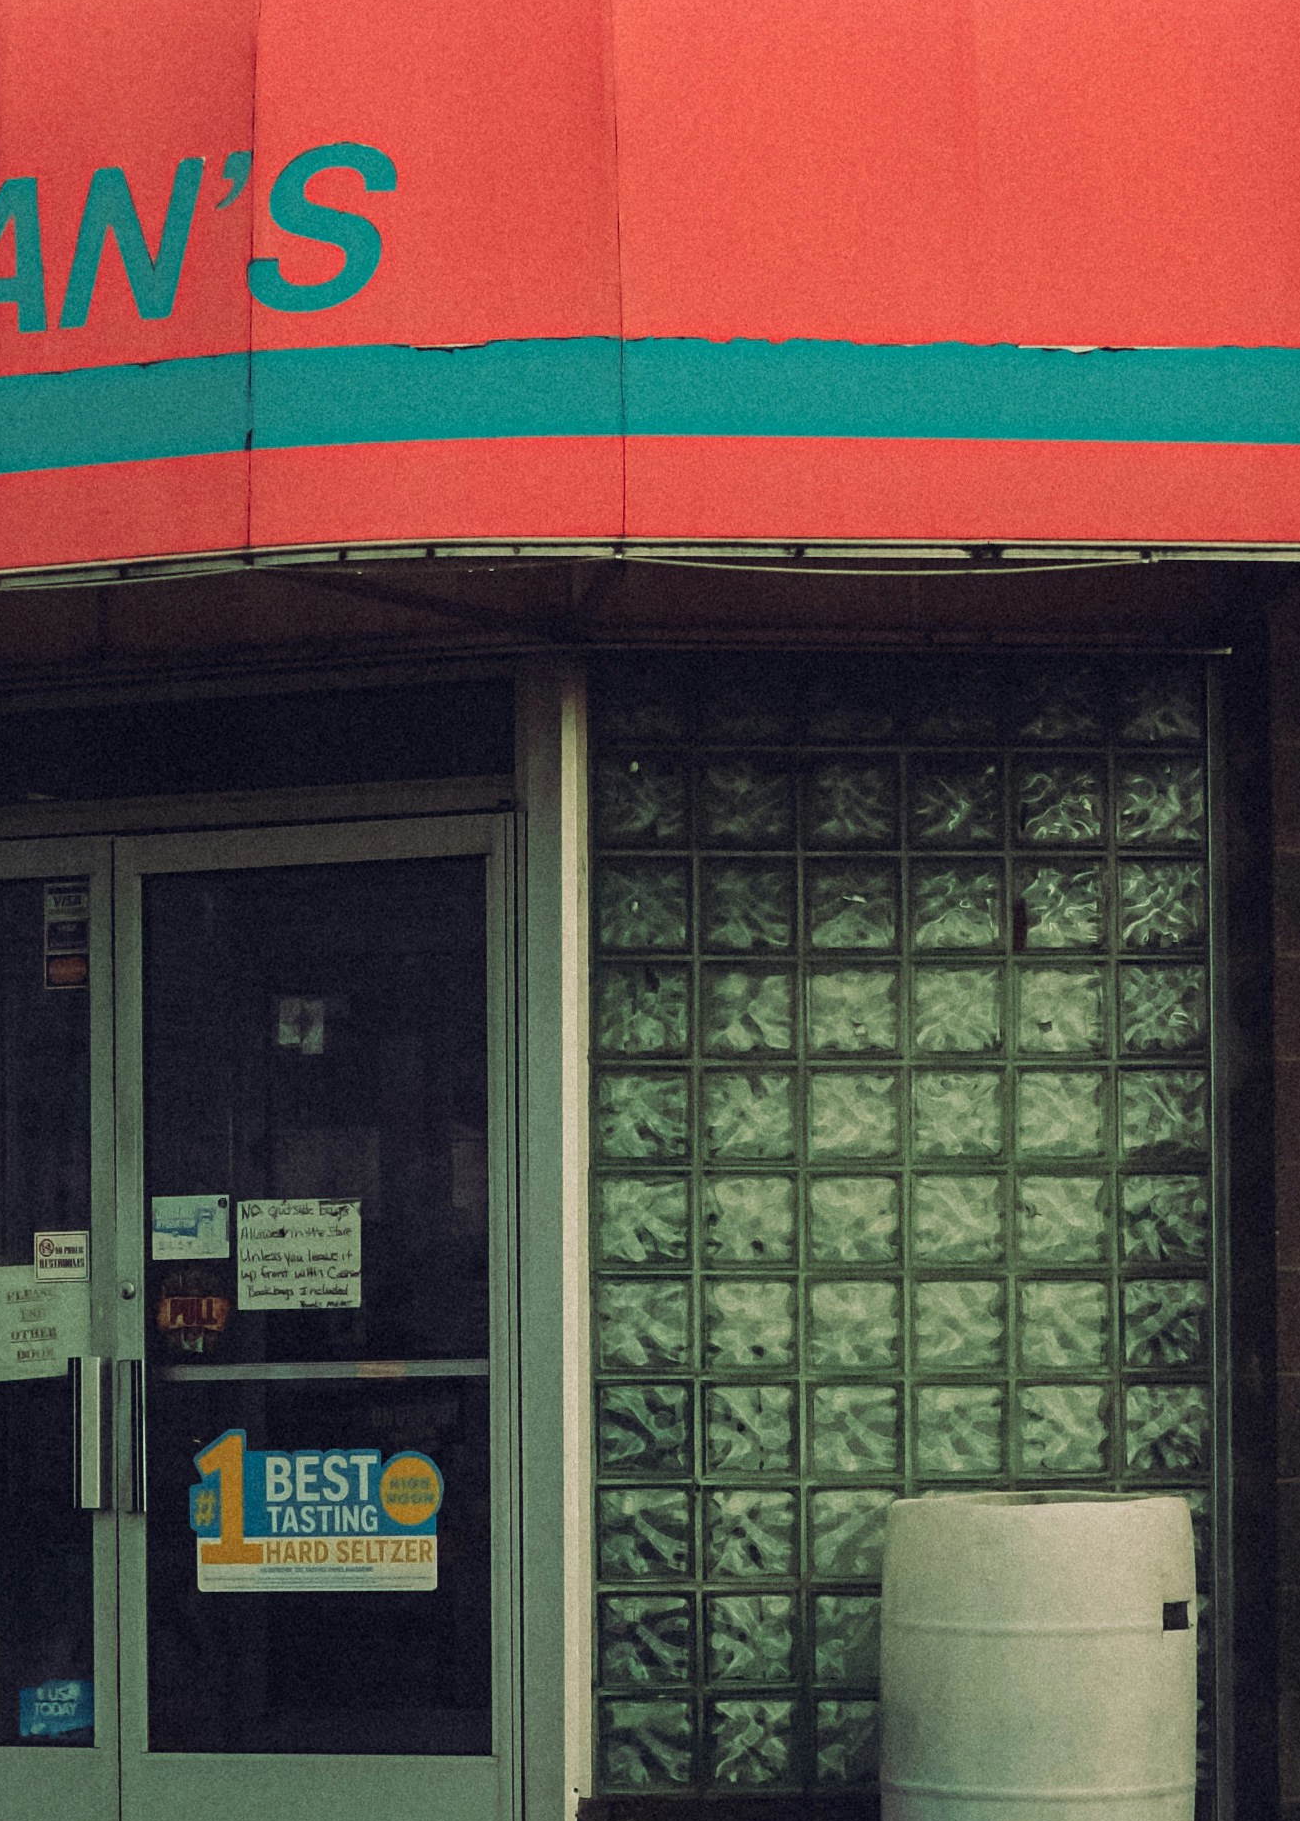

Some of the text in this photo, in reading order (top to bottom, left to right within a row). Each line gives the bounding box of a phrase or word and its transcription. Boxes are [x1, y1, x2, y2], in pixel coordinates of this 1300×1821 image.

[240, 1204, 263, 1220] NO
[64, 1246, 85, 1255] PUBLIC
[39, 1258, 85, 1269] RESTROOMS
[170, 1298, 218, 1326] PULL
[10, 1327, 58, 1340] OTHER
[265, 1454, 378, 1502] BEST
[386, 1492, 435, 1505] NOON
[267, 1504, 379, 1533] TASTING
[266, 1538, 434, 1564] HARD SELTZER
[34, 1701, 78, 1716] TODAY
